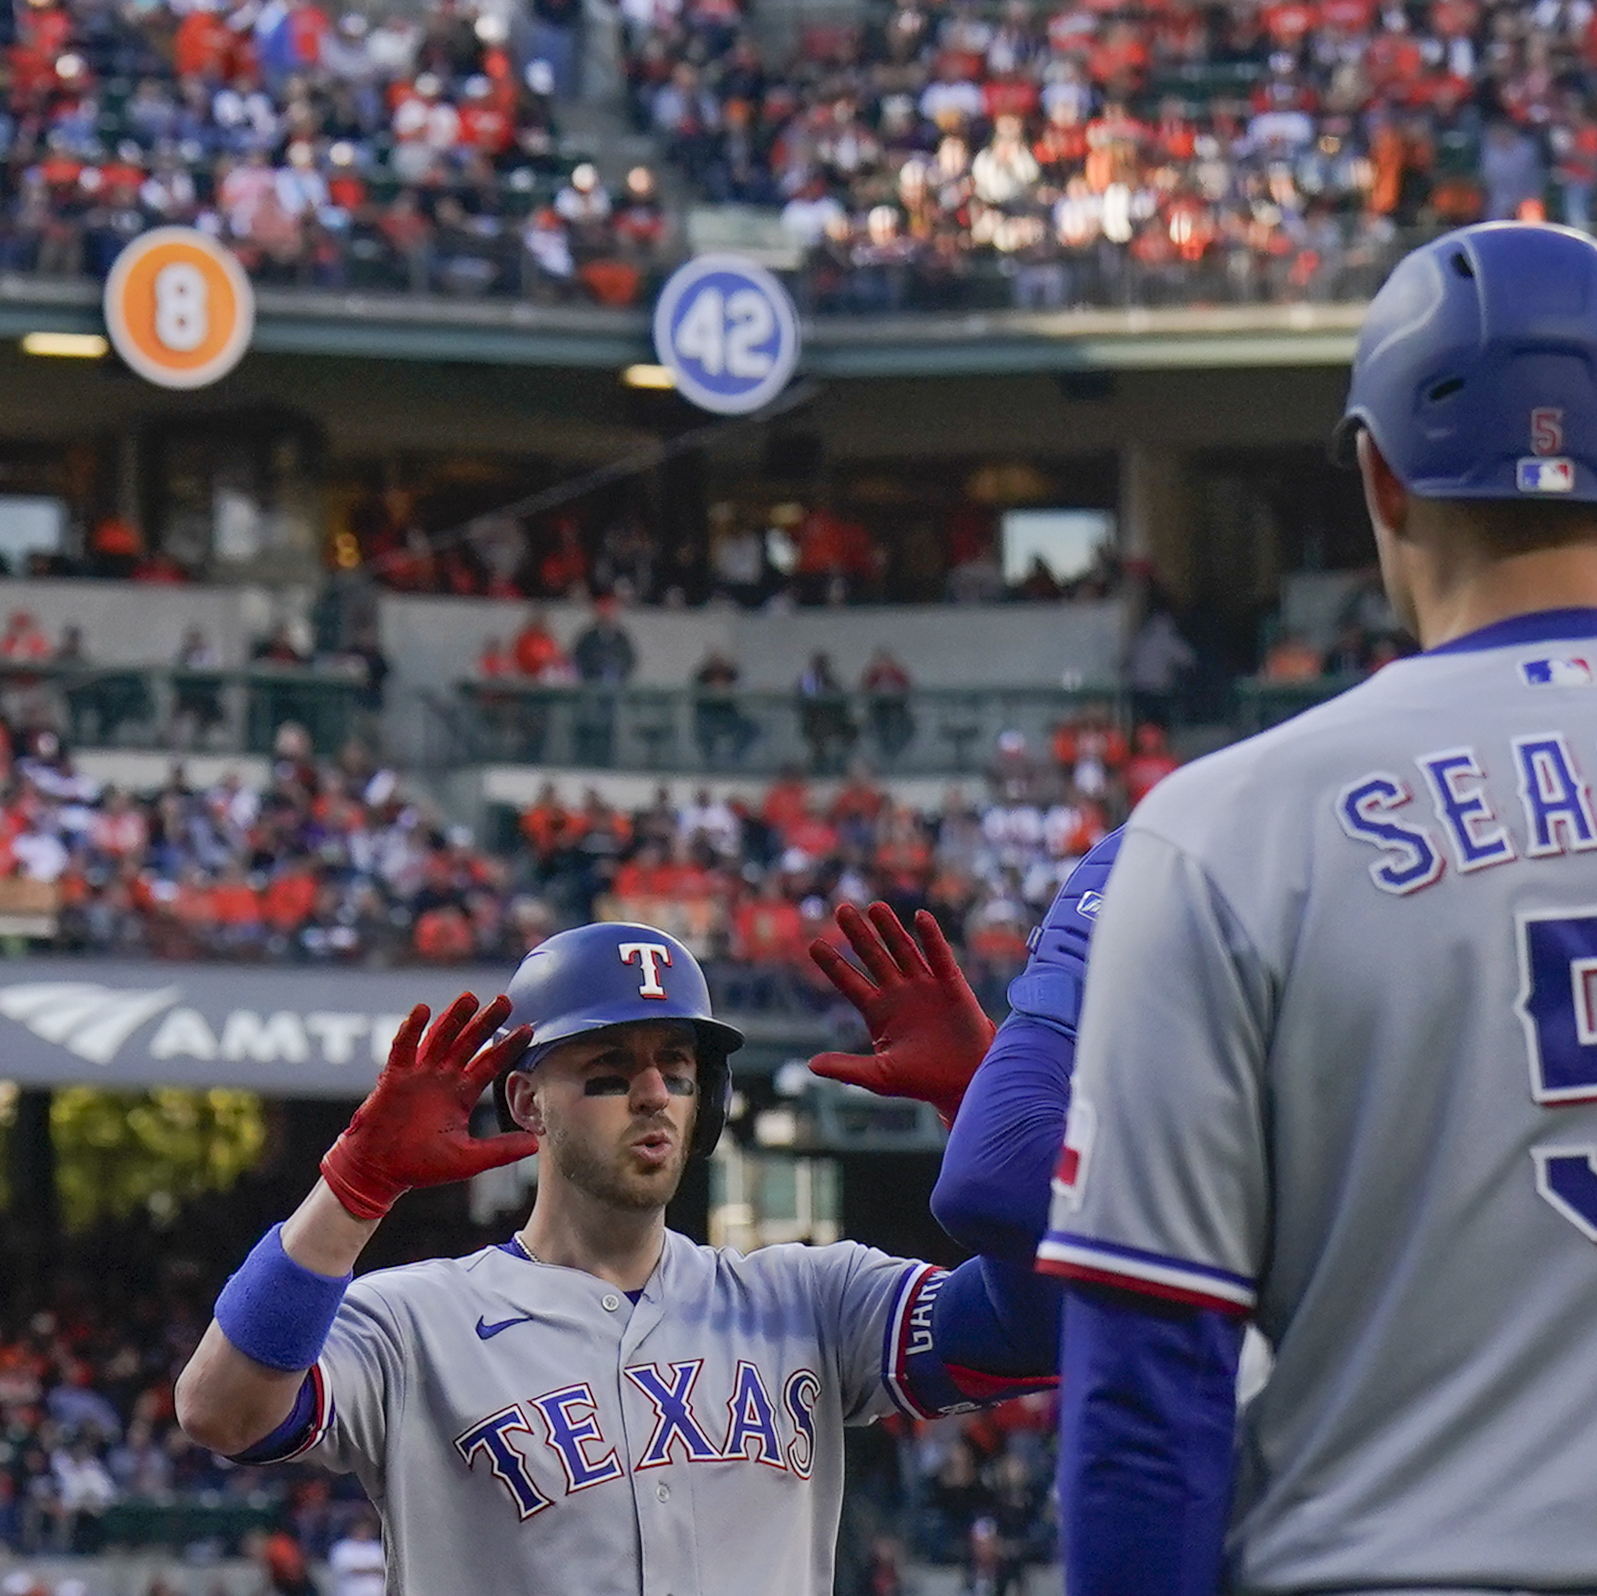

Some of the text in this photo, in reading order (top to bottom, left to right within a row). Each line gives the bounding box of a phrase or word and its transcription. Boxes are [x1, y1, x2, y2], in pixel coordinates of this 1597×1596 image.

[155, 261, 210, 352] 8
[674, 286, 774, 378] 42
[1530, 406, 1564, 455] 5
[618, 942, 673, 1000] T
[454, 1357, 822, 1523] TEXAS
